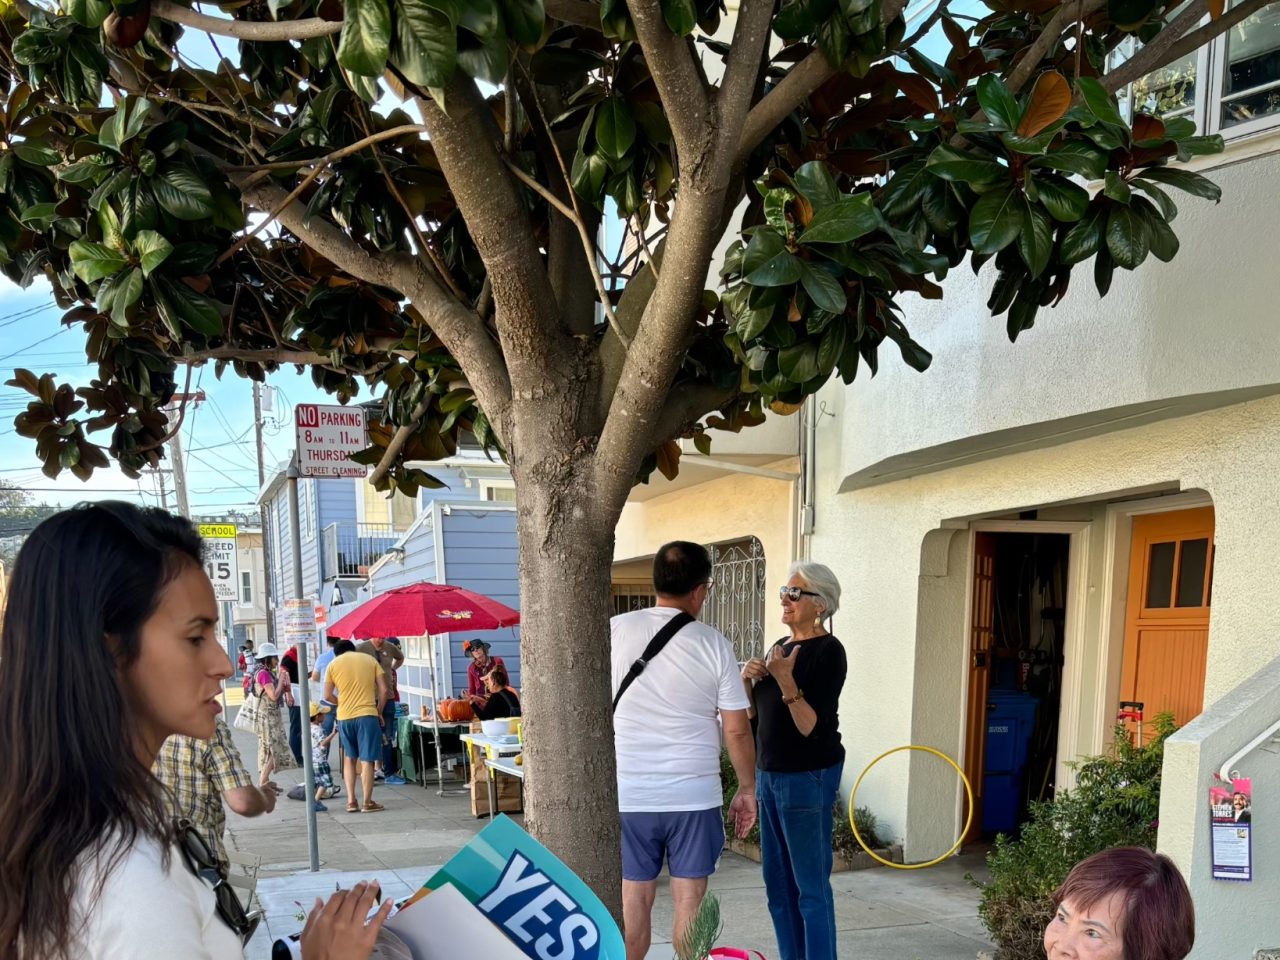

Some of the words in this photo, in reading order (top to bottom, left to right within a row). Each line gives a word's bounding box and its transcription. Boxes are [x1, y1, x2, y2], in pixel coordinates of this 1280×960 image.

[299, 407, 316, 425] NO
[321, 412, 361, 427] PARKING
[306, 466, 328, 474] STREET
[332, 467, 362, 475] CLEANING
[200, 527, 234, 535] SCHOOL
[208, 562, 231, 579] 15
